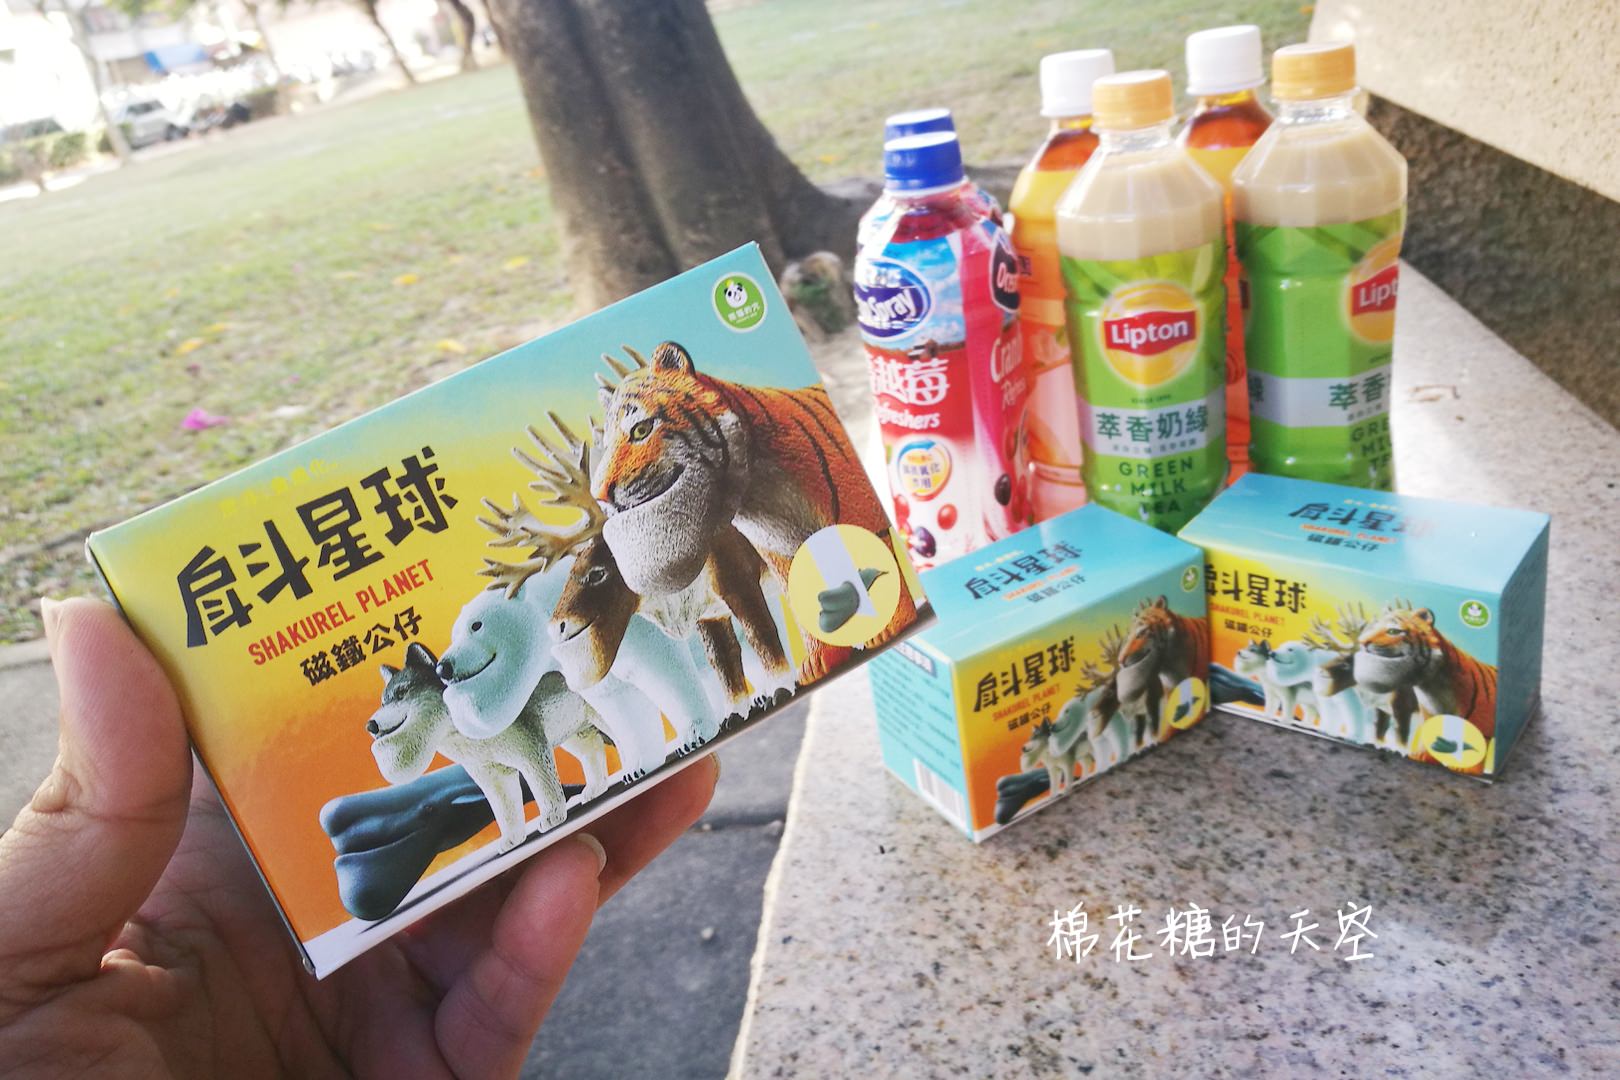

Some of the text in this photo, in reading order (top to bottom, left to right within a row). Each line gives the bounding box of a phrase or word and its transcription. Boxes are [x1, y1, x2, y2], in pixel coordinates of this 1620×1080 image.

[1111, 320, 1188, 349] Lipton
[1328, 372, 1391, 411] 萃香
[1096, 405, 1209, 442] 萃香奶綠
[1119, 457, 1193, 478] GREEN
[1131, 477, 1186, 496] MILK
[177, 446, 458, 648] 戽斗星球
[248, 558, 435, 666] SHAKUREL PLANET
[300, 606, 423, 686] 磁鐵公仔
[974, 636, 1076, 712] 戽斗星球
